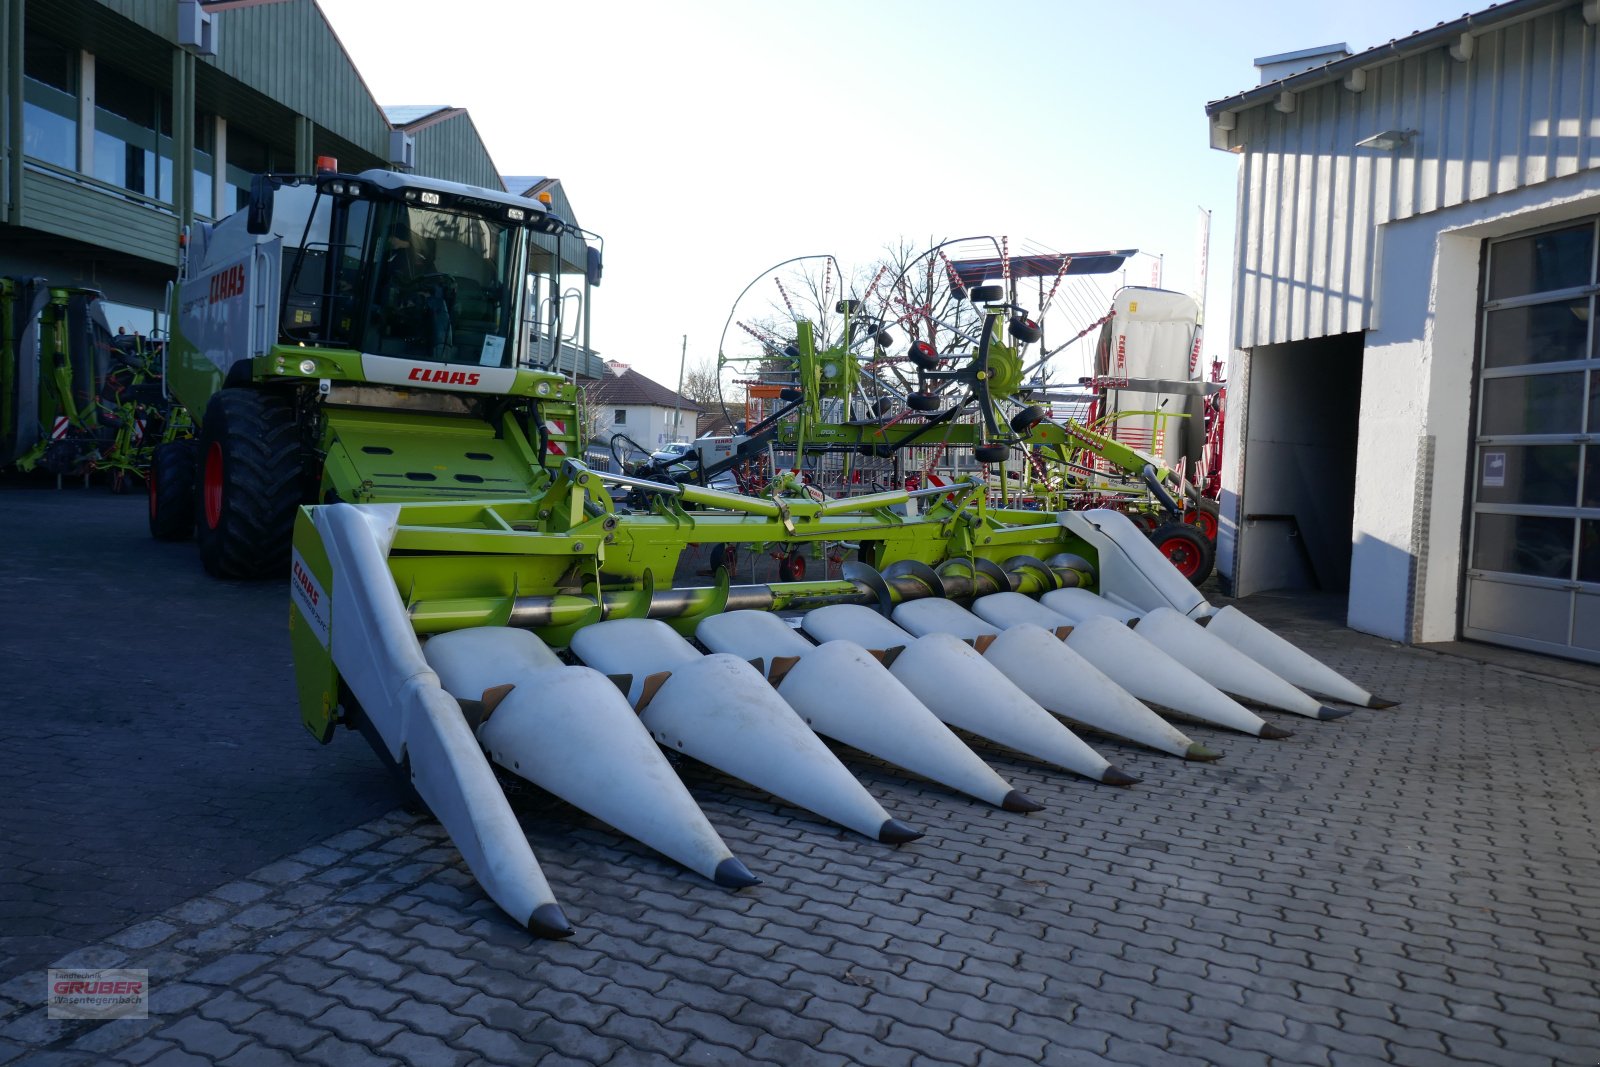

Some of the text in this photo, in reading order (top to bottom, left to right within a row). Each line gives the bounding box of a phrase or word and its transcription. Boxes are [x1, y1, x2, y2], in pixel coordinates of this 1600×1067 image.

[209, 263, 245, 304] CLAAS
[1118, 335, 1126, 369] CLAAS
[1189, 337, 1201, 373] CLAAS
[408, 367, 481, 386] CLAAS
[1069, 465, 1092, 477] CLAAS
[293, 560, 320, 607] CLAAS
